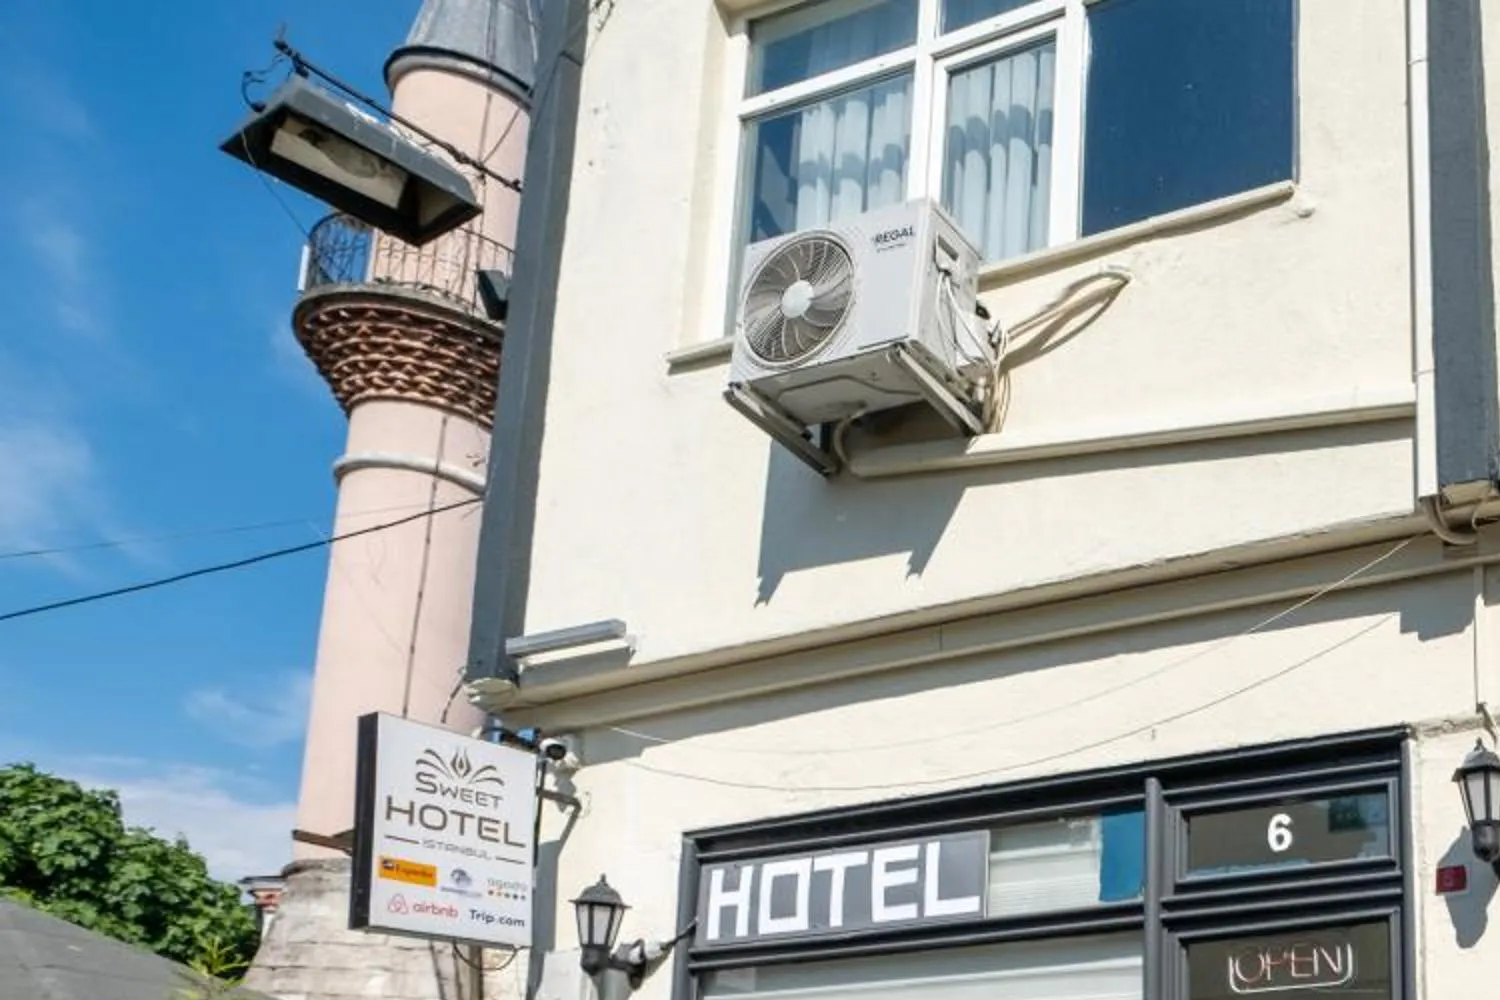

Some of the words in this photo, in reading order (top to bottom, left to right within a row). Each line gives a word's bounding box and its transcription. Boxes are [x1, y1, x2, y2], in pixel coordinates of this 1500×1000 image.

[415, 771, 503, 809] SWEET
[385, 795, 527, 849] HOTEL
[1267, 813, 1295, 853] 6
[412, 901, 460, 918] airbnb
[706, 840, 981, 941] HOTEL
[1234, 946, 1343, 984] OPEN
